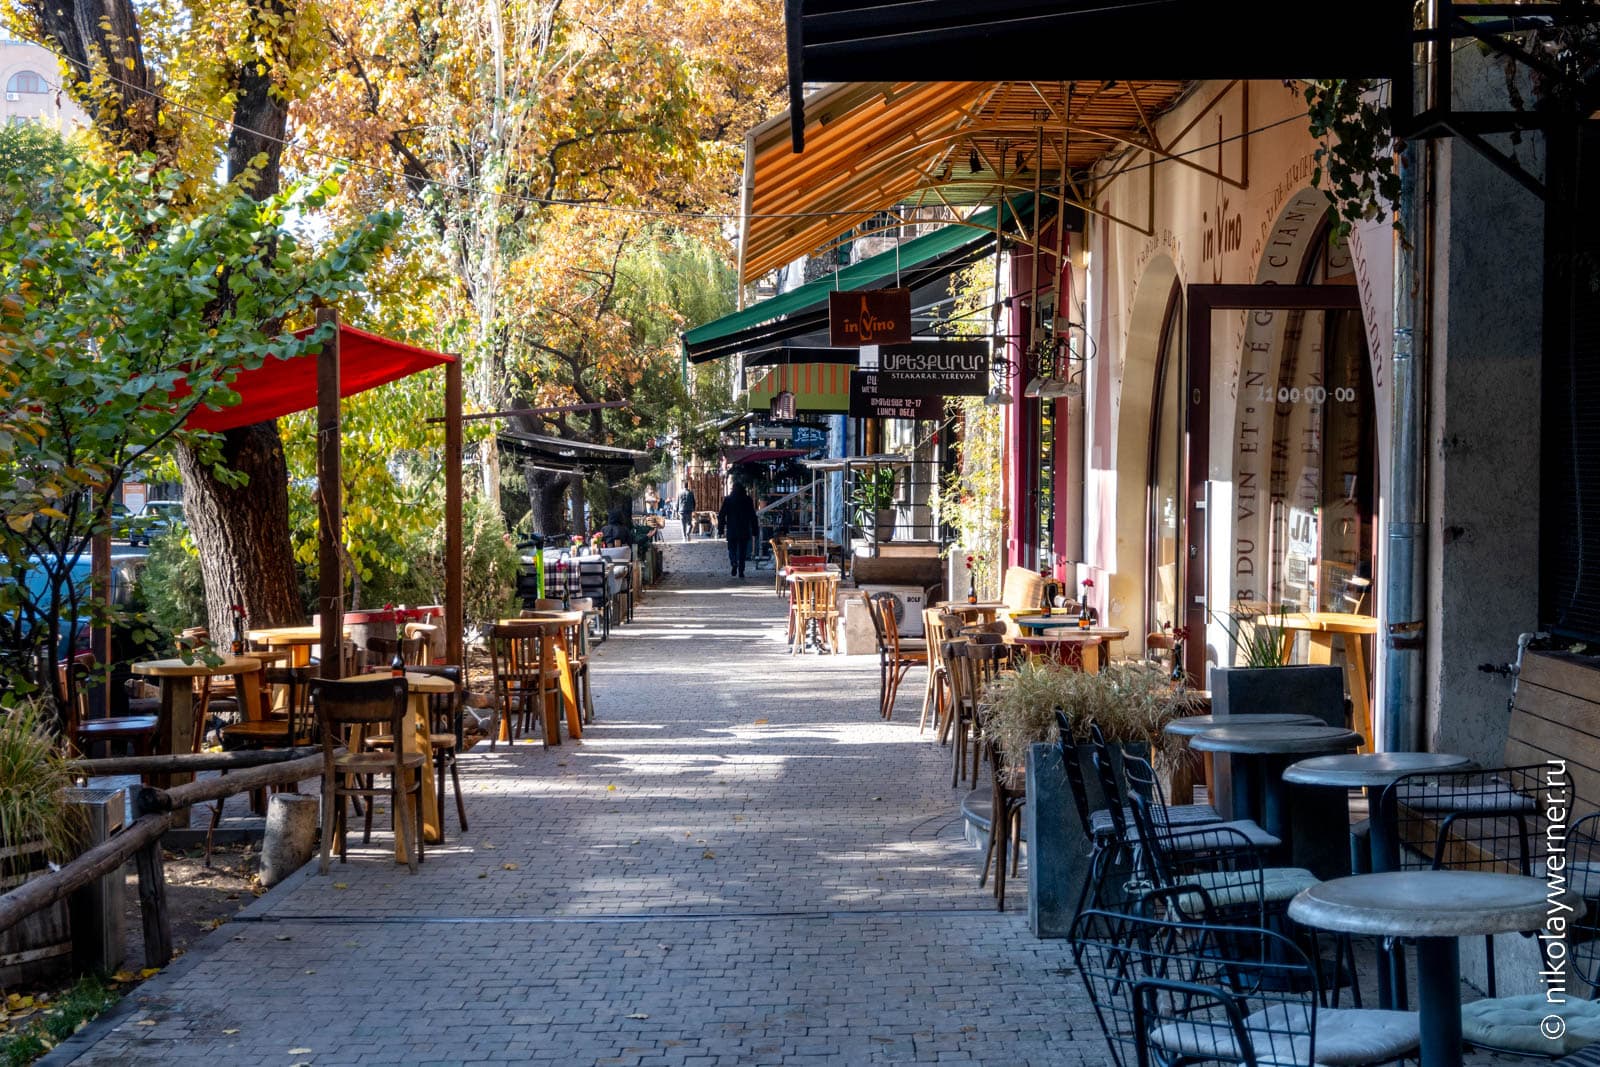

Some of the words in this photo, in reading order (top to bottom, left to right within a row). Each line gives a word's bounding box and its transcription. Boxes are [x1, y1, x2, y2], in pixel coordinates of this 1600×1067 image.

[877, 407, 896, 416] LUNCH
[1240, 422, 1259, 455] ET
[1238, 472, 1256, 522] VIN
[1237, 538, 1254, 577] DU
